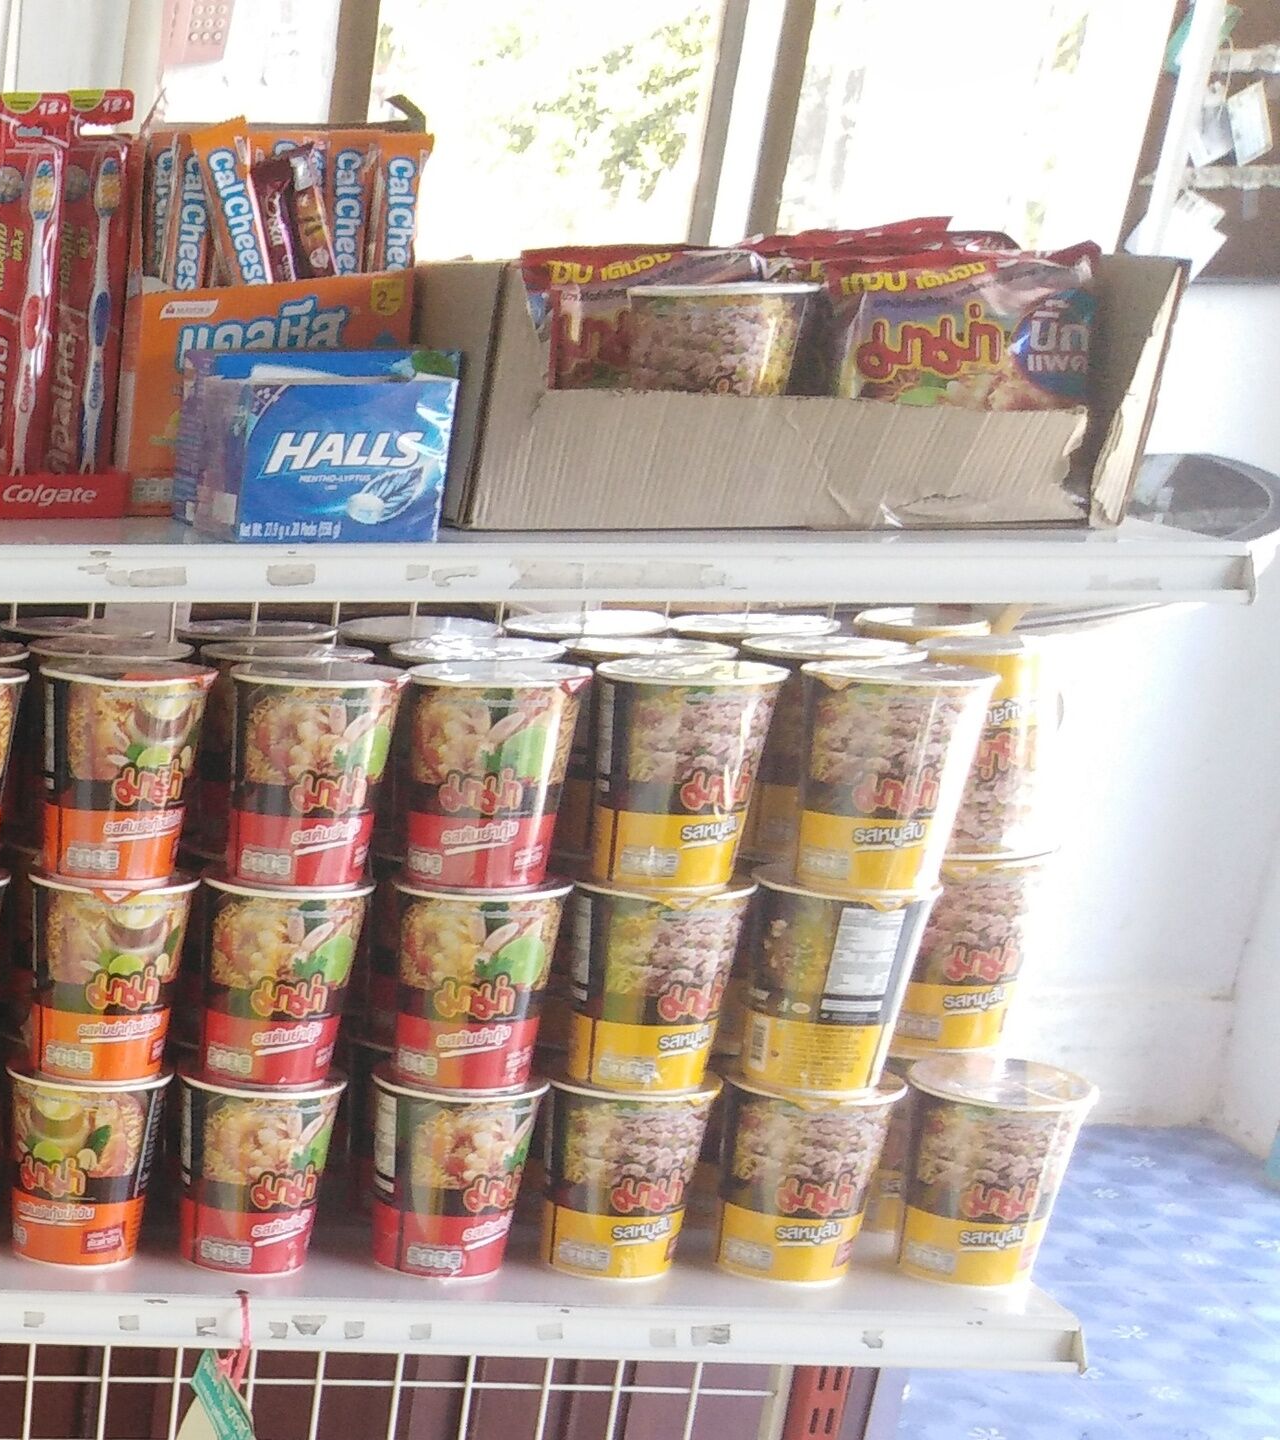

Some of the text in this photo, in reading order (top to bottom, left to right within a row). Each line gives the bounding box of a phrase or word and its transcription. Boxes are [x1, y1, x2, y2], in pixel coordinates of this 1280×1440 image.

[856, 302, 1003, 382] มาม่า
[263, 432, 425, 475] HALLS
[2, 484, 98, 507] Colgate
[289, 766, 368, 814] มาม่า
[440, 767, 524, 815] มาม่า
[852, 821, 926, 847] รสหมูสับ
[86, 964, 160, 1011] มาม่า
[250, 973, 328, 1019] มาม่า
[433, 974, 518, 1021] มาม่า
[20, 1155, 89, 1199] มาม่า
[610, 1168, 684, 1213] มาม่า
[776, 1172, 854, 1216] มาม่า
[774, 1220, 843, 1245] รสหมูสับ
[958, 1224, 1028, 1249] รสหมูสับ
